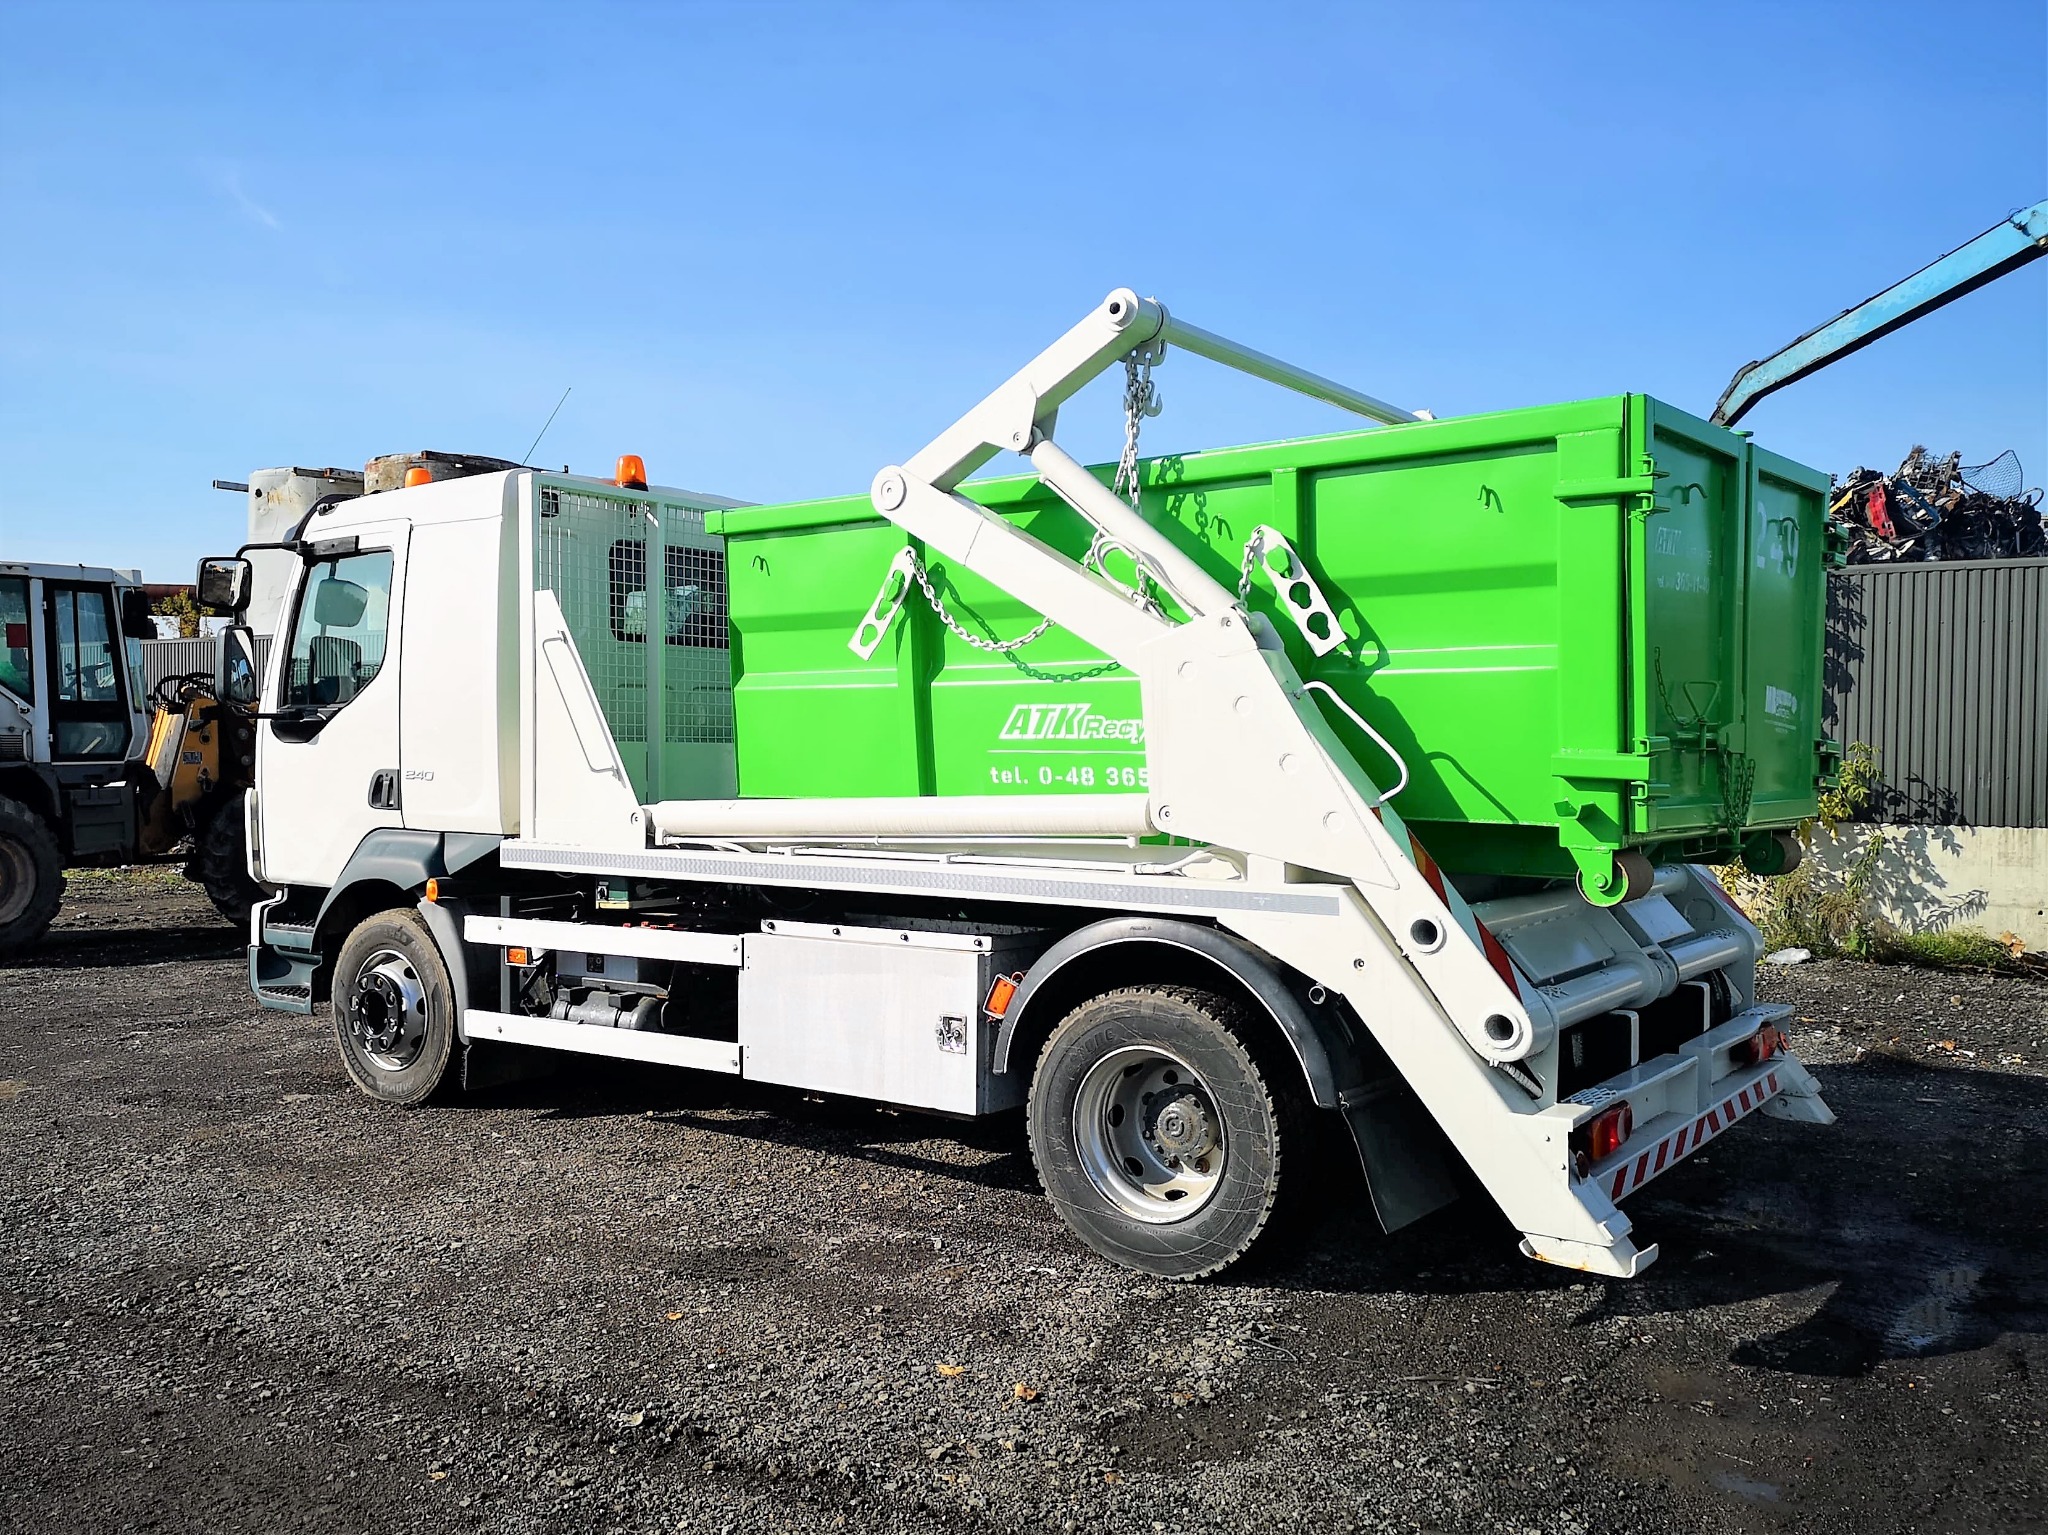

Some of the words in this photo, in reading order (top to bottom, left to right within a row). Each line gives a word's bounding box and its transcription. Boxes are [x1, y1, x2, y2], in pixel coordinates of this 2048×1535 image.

[998, 703, 1092, 739] ATK
[405, 770, 434, 781] 240
[990, 765, 1029, 784] tel.
[1038, 765, 1095, 786] 0-48
[1105, 766, 1149, 787] 365
